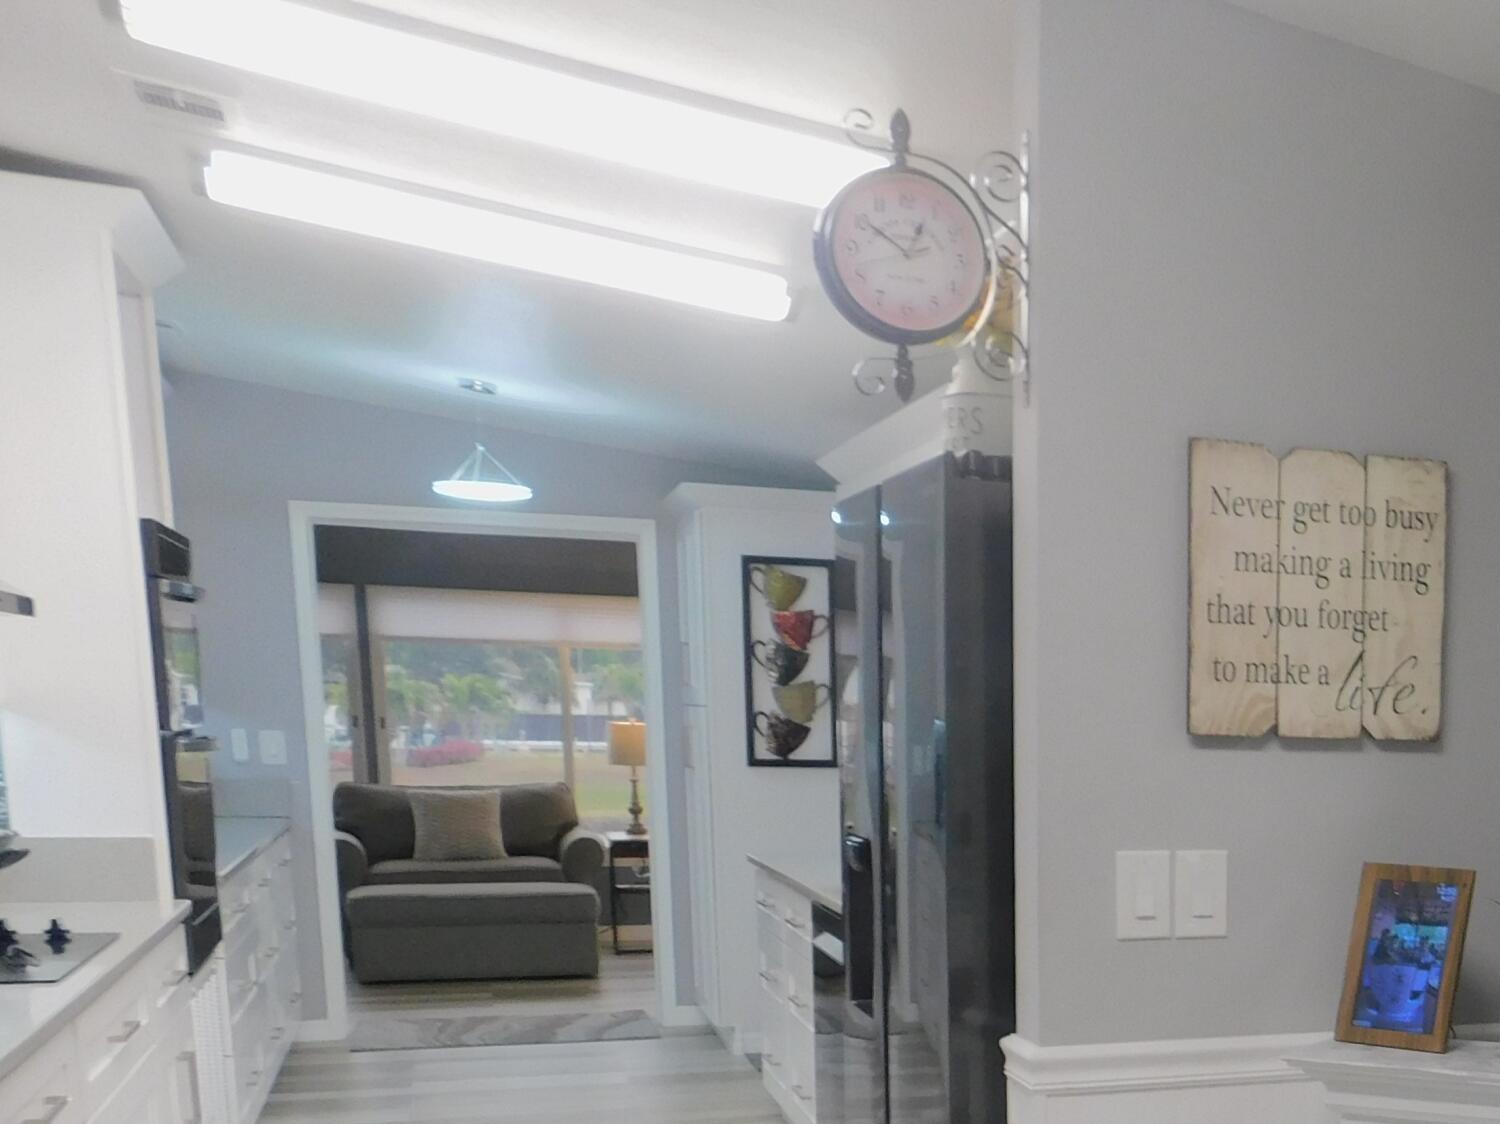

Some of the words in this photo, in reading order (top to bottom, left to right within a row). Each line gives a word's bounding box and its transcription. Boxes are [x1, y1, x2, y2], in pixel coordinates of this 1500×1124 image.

[1208, 485, 1286, 521] Never
[1293, 499, 1331, 534] get
[1339, 502, 1377, 528] too
[1384, 499, 1439, 543] busy
[1233, 545, 1332, 590] making
[1339, 559, 1353, 579] a
[1361, 550, 1432, 596] living
[1206, 593, 1255, 626] that
[1263, 604, 1309, 639] you
[1317, 599, 1390, 643] forget
[1212, 656, 1237, 683] to
[1244, 654, 1310, 685] make
[1317, 666, 1331, 686] a
